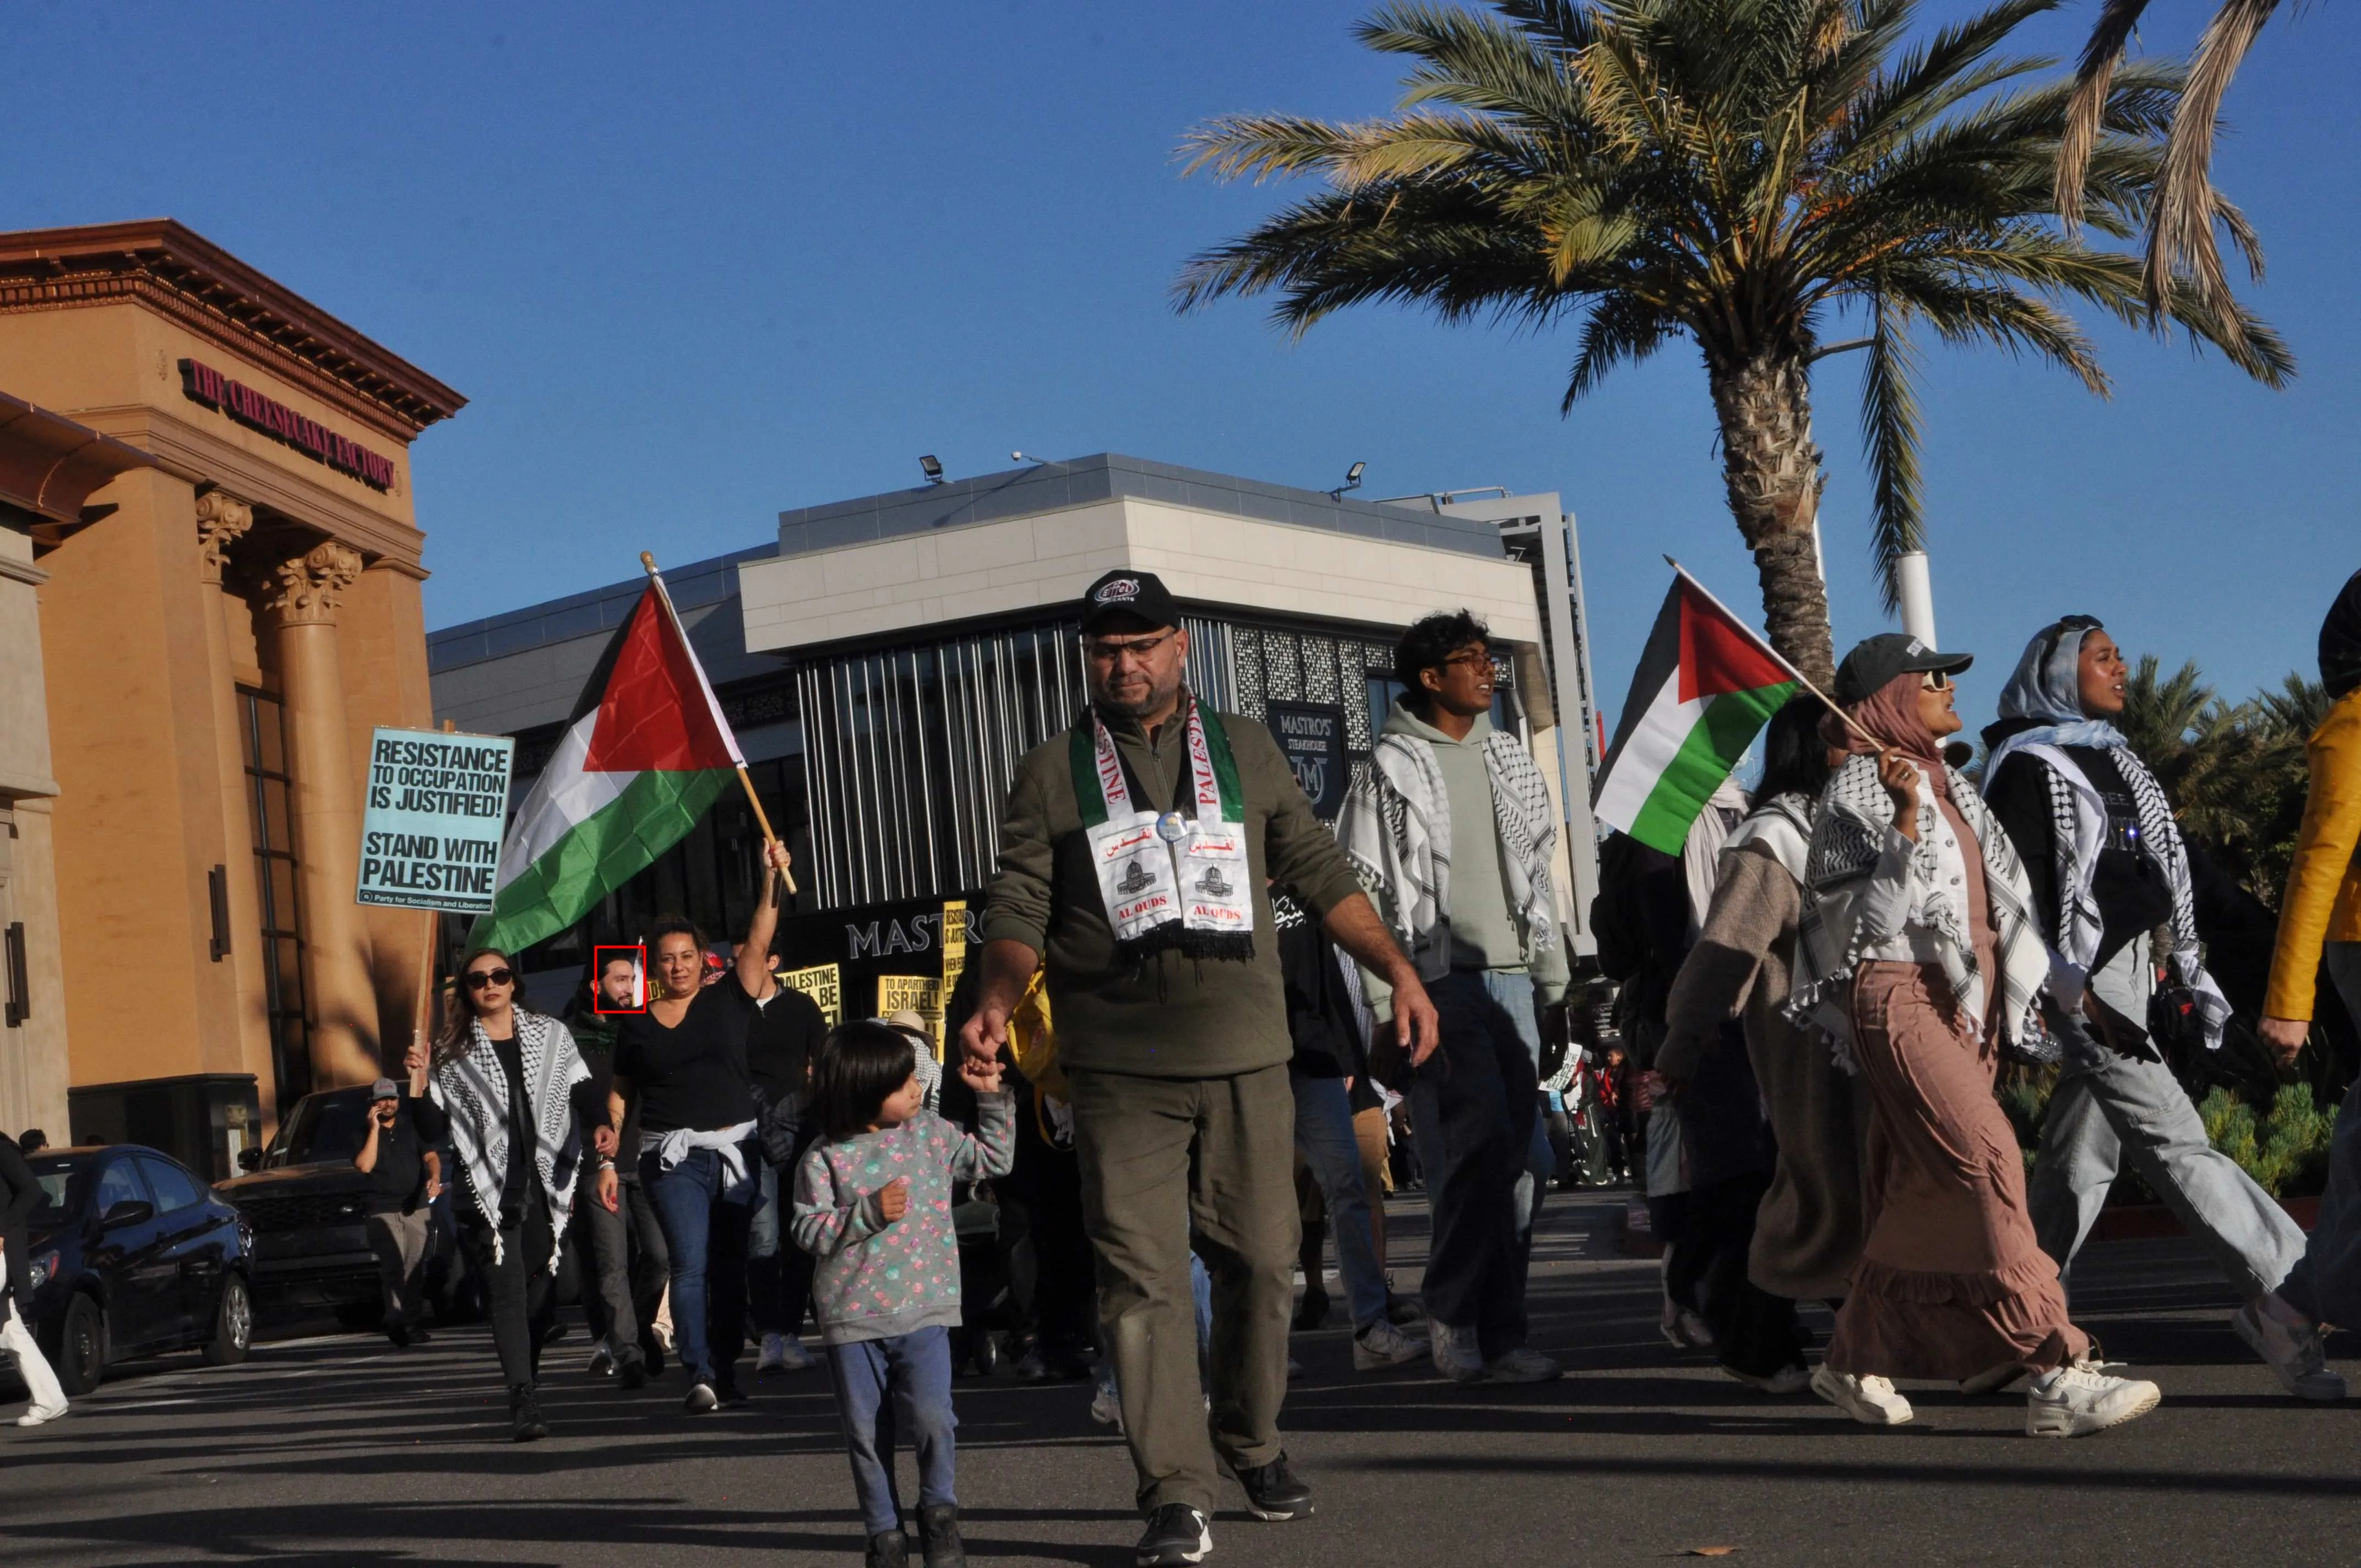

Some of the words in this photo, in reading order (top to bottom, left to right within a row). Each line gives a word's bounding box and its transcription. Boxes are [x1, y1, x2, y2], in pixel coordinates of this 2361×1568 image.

[191, 358, 227, 406] THE
[230, 379, 330, 456] CHEESECAKE
[335, 432, 395, 489] FACTORY
[1280, 715, 1332, 736] MASTRO'S
[375, 739, 508, 773] RESISTANCE
[373, 765, 394, 785] TO
[398, 768, 505, 793] OCCUPATION
[371, 786, 391, 809] IS
[395, 788, 502, 818] JUSTIFIED!
[2097, 791, 2130, 806] REE
[366, 831, 438, 859] STAND
[444, 838, 497, 864] WITH
[363, 858, 494, 894] PALESTINE
[374, 895, 394, 903] Party
[407, 897, 441, 906] Socialism
[1119, 907, 1133, 920] AL
[1135, 895, 1166, 913] QUDS
[1194, 905, 1209, 915] AL
[1211, 907, 1241, 920] QUDS
[846, 910, 987, 959] MASTR
[782, 967, 837, 989] ALESTINE
[885, 978, 895, 989] TO
[819, 985, 837, 1007] BE
[887, 990, 938, 1010] ISRAEL!
